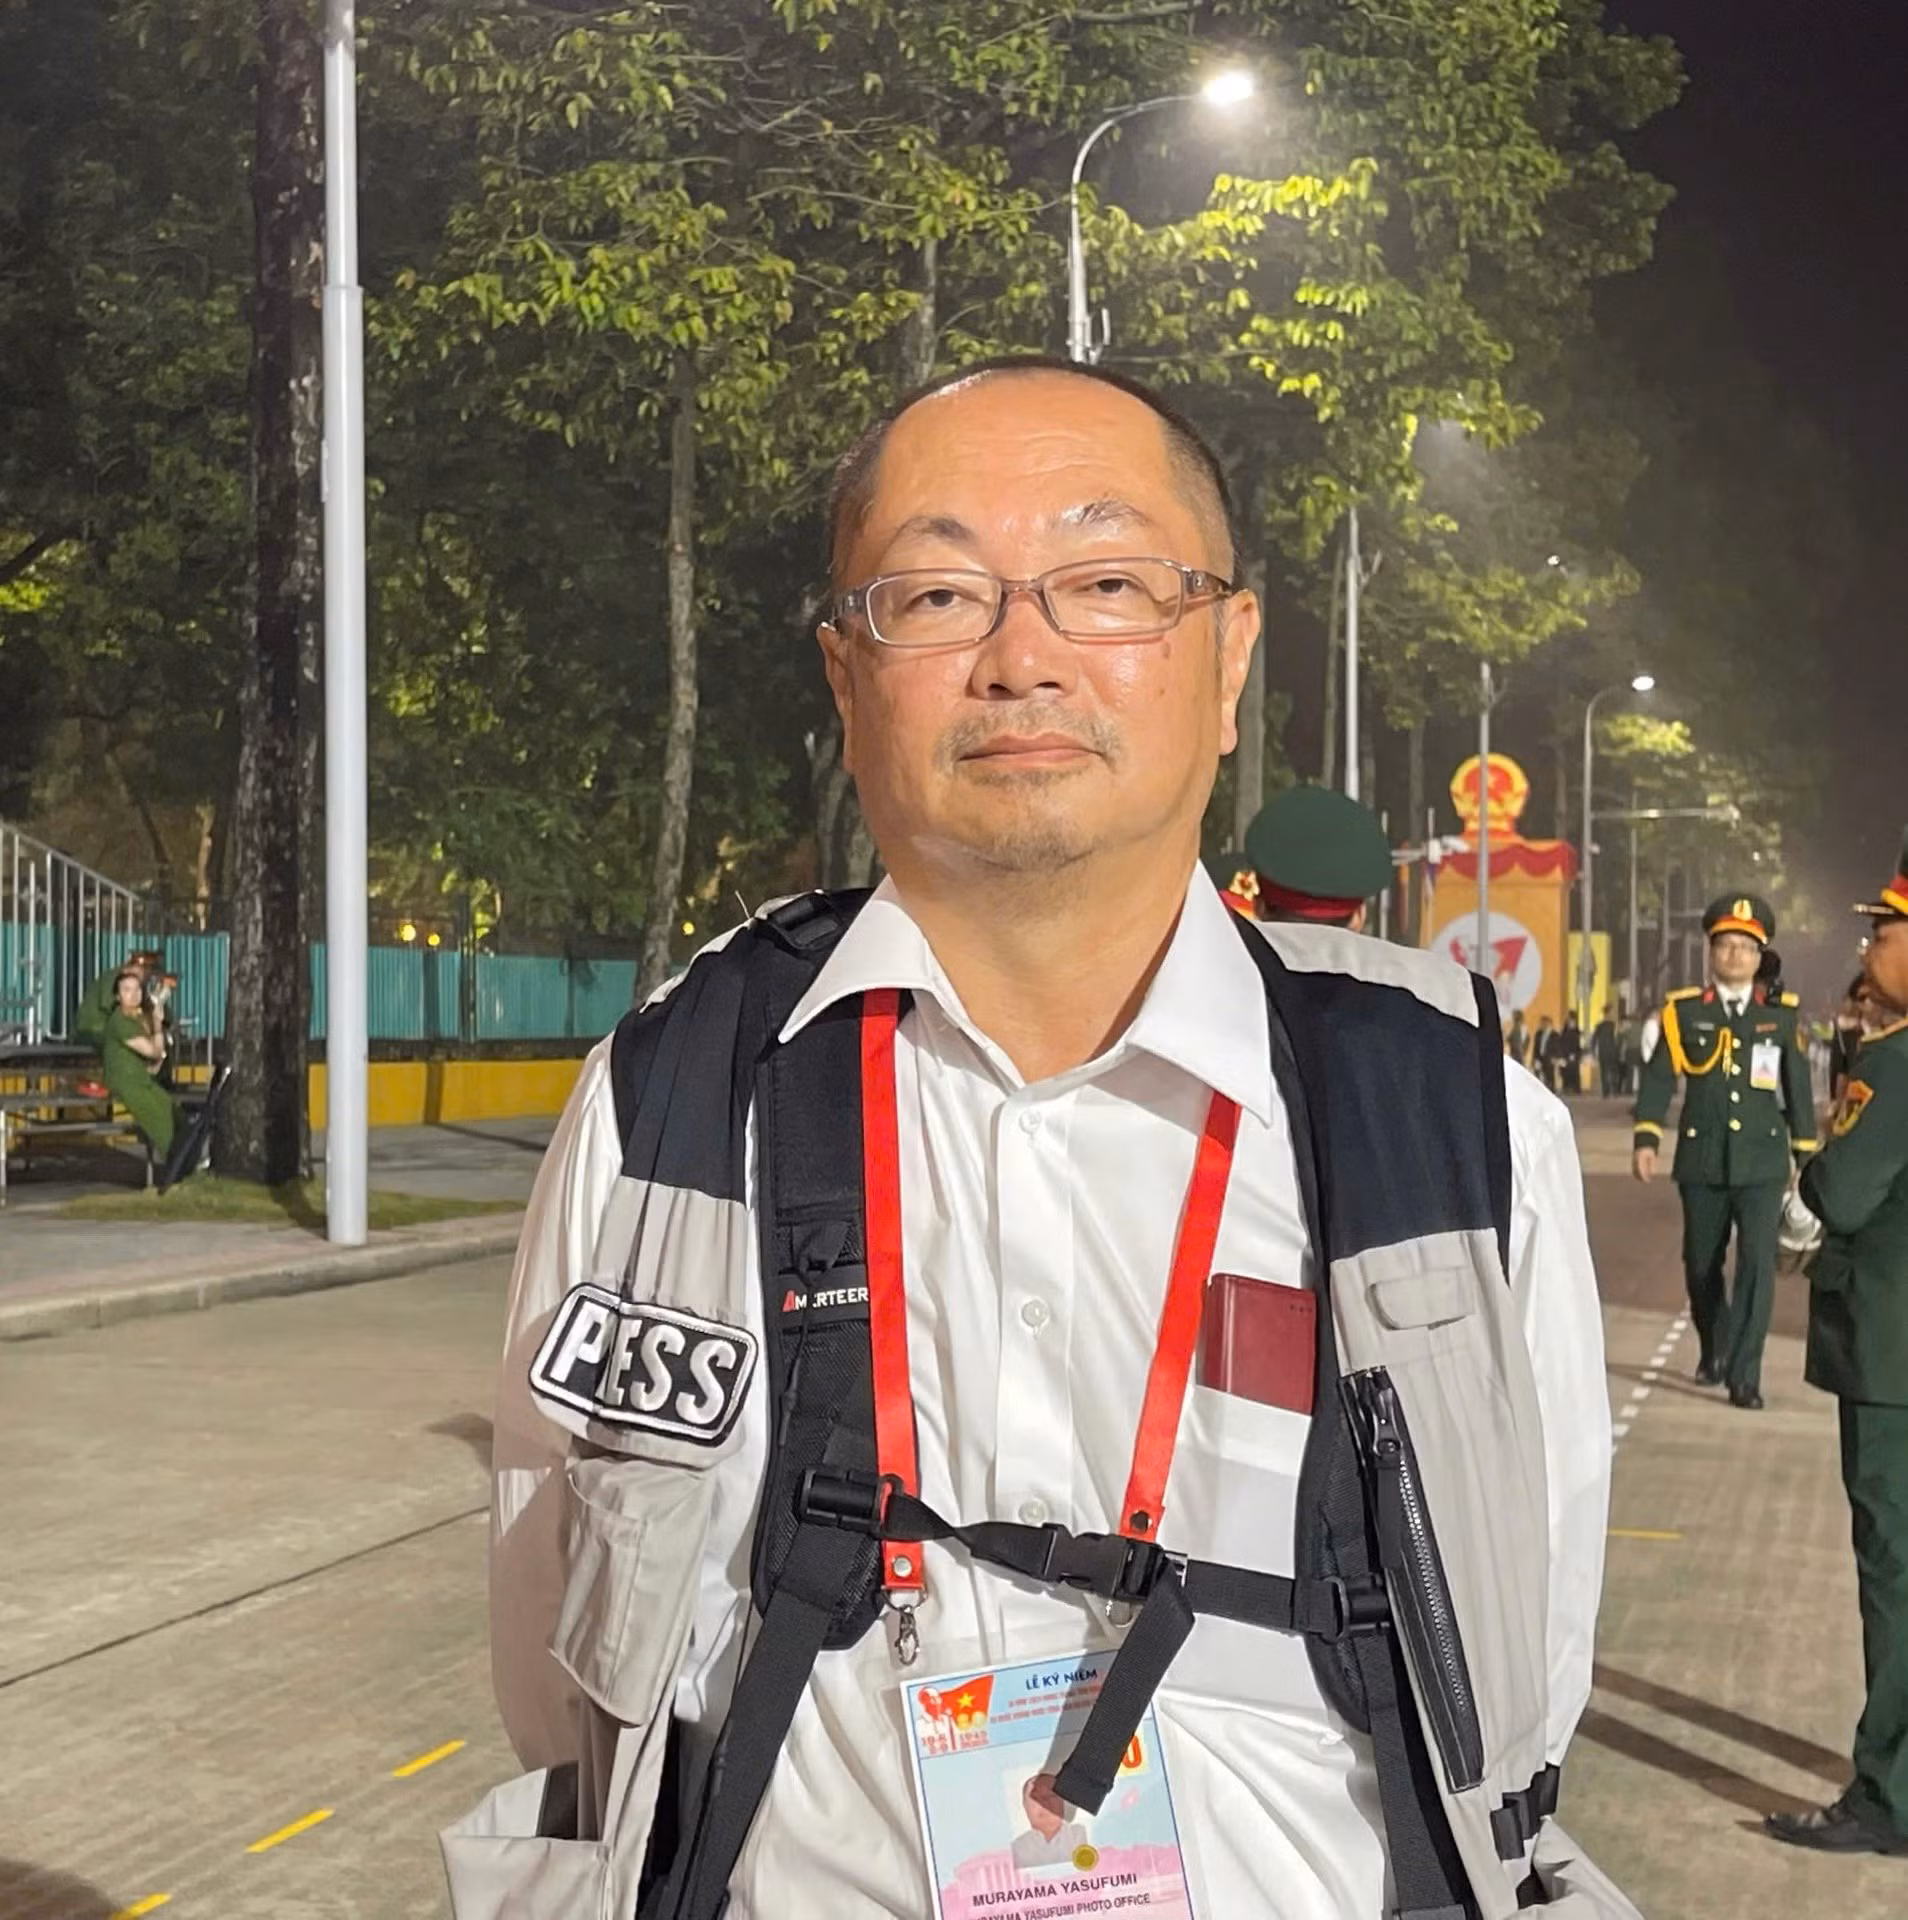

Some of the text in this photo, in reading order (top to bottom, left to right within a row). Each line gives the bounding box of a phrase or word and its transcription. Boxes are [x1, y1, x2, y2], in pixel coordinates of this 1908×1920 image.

[782, 1287, 869, 1313] AMRTEER
[973, 1873, 1138, 1907] MURAYAMA YASUFUMI
[1077, 1899, 1113, 1913] PHOTO
[1114, 1893, 1150, 1908] OFFICE
